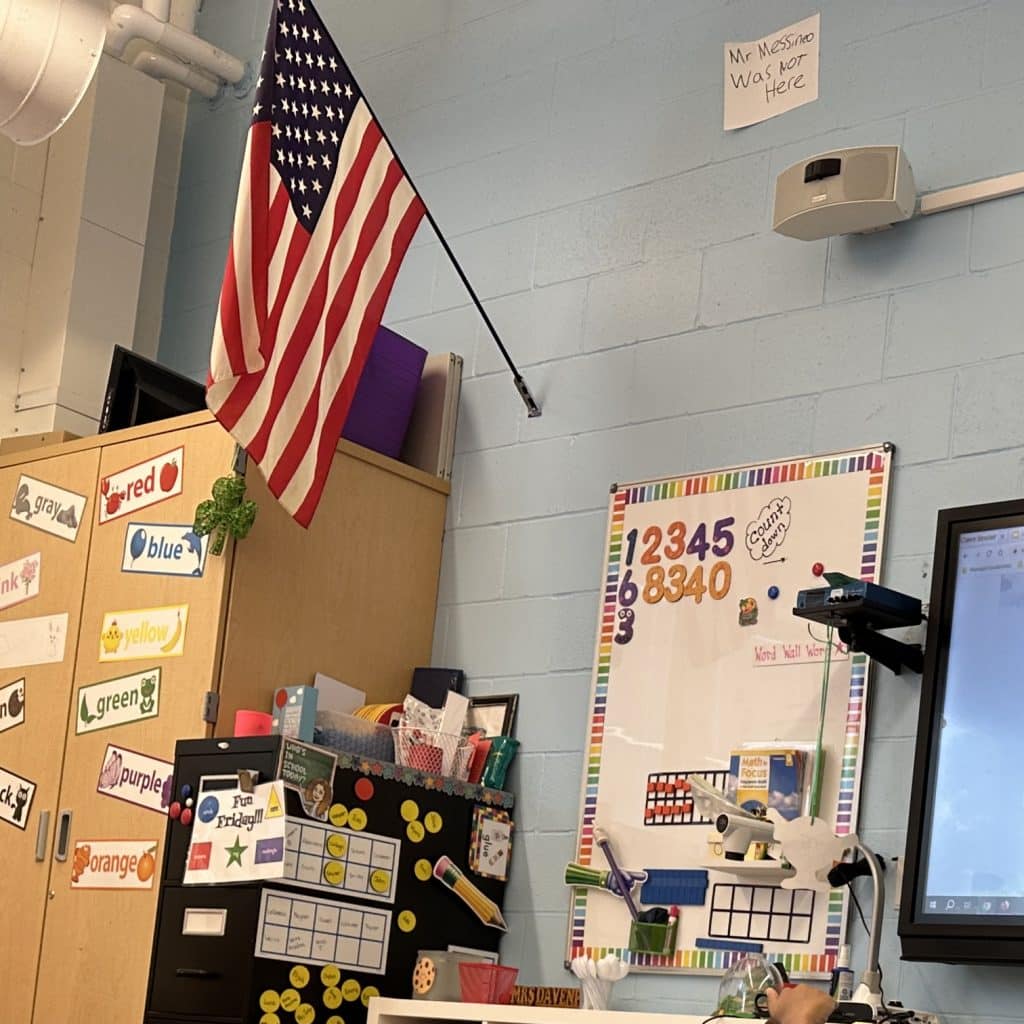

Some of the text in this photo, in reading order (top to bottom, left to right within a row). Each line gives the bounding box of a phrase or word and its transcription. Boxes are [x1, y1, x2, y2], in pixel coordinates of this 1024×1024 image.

[731, 64, 771, 88] Was
[765, 74, 805, 103] Here
[127, 467, 155, 500] red
[34, 496, 61, 520] gray
[147, 536, 183, 560] blue
[761, 521, 786, 552] down
[124, 620, 168, 649] yellow
[97, 688, 139, 719] green
[742, 757, 762, 767] Math
[121, 767, 161, 793] purple
[232, 794, 253, 808] Fun
[216, 808, 263, 831] Friday!!!
[90, 854, 136, 879] orange
